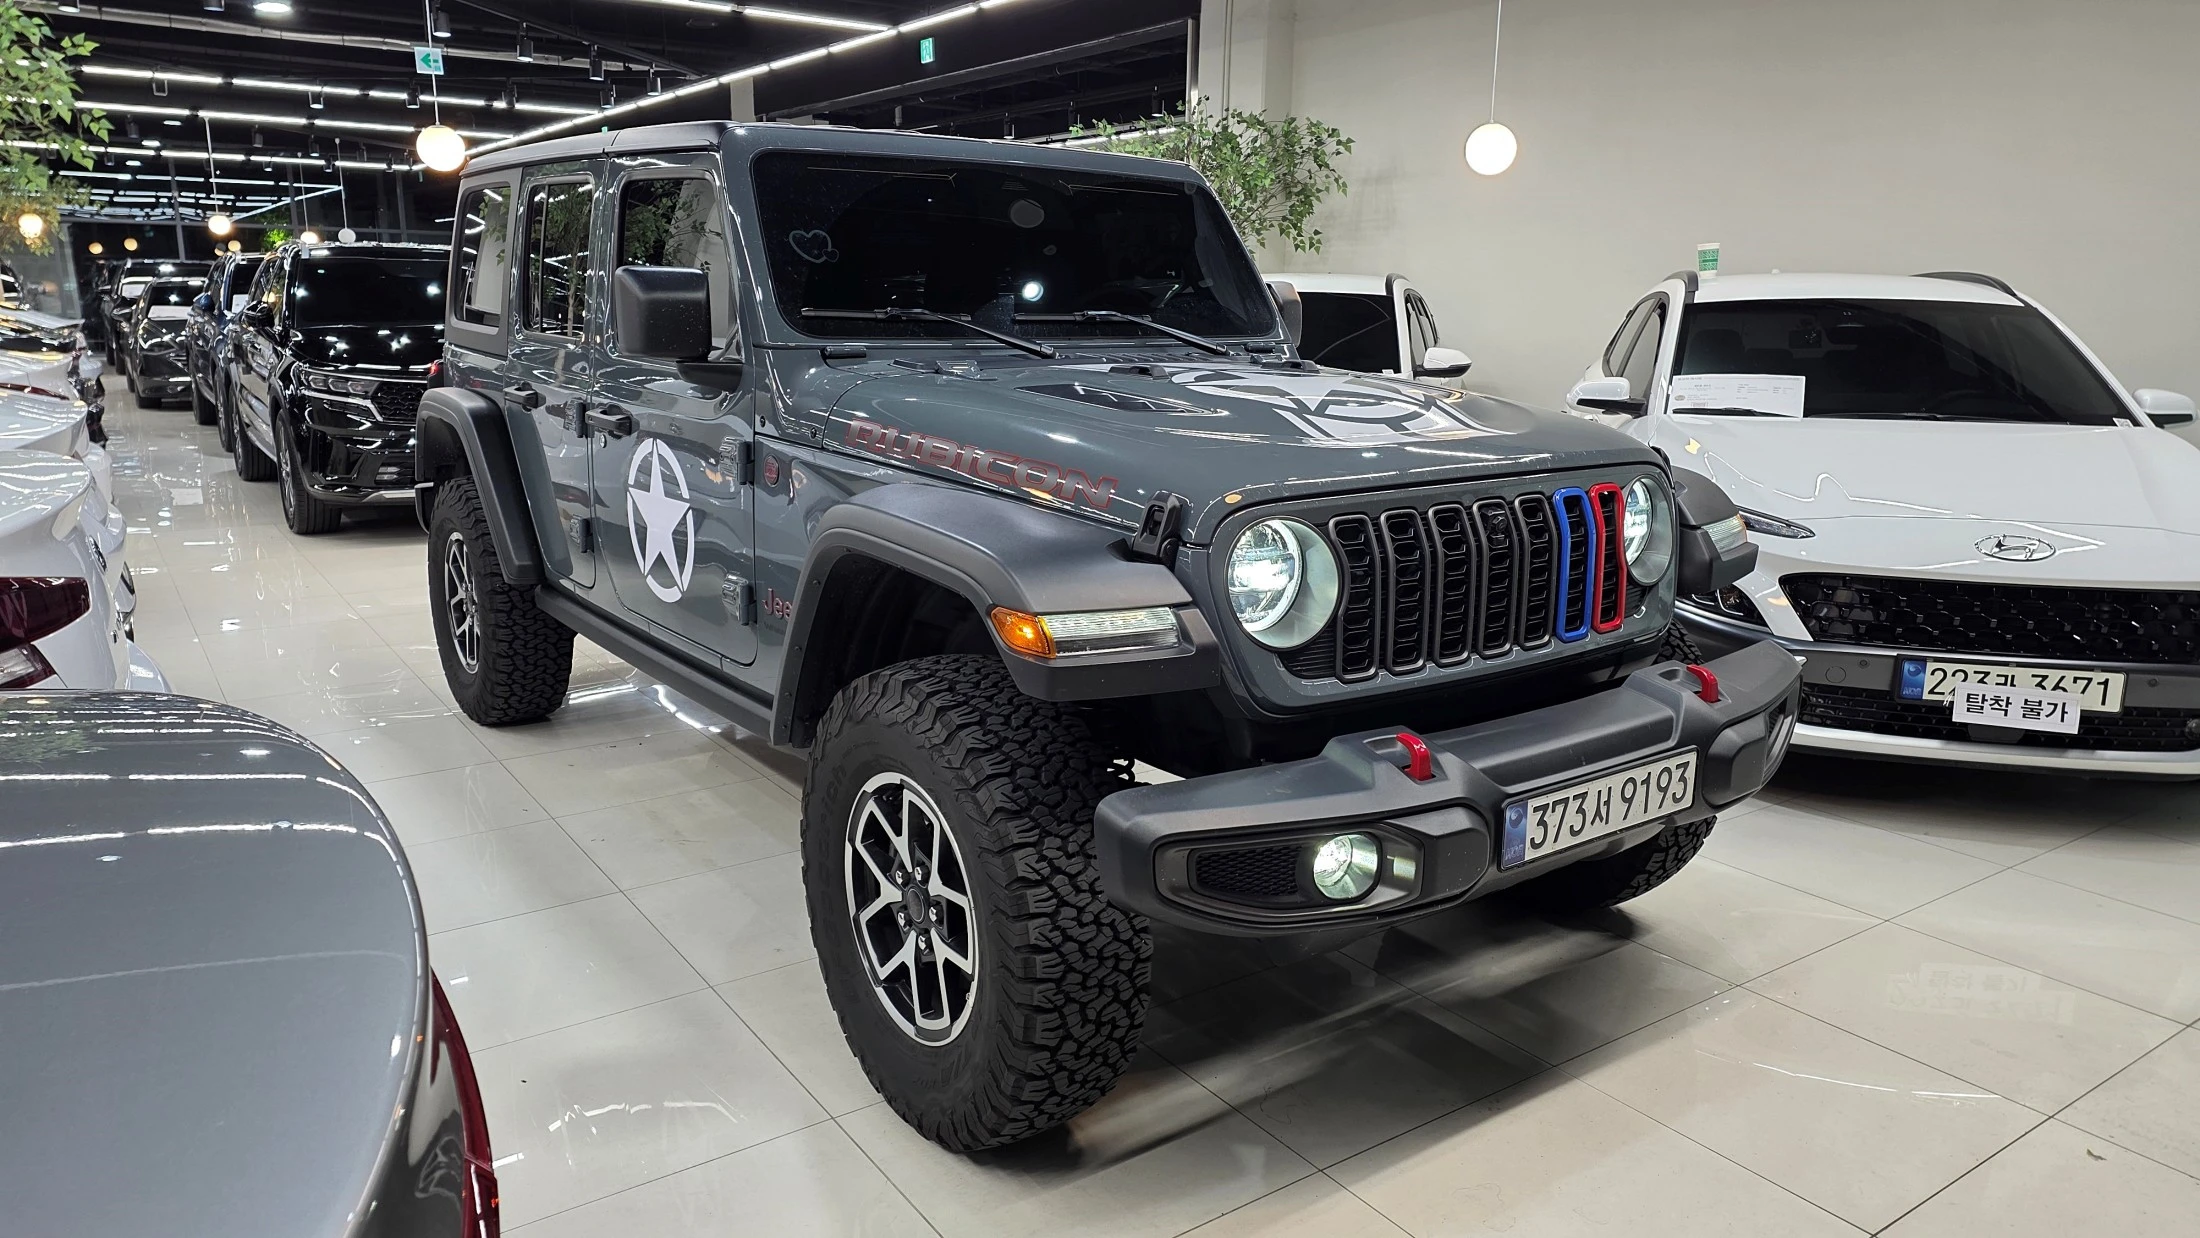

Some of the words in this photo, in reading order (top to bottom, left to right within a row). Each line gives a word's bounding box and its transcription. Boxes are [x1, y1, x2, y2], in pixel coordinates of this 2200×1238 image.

[846, 418, 1119, 509] RUBICON
[762, 587, 793, 622] Jee
[1965, 692, 2013, 717] 탈착
[2020, 698, 2069, 723] 불가
[1529, 785, 1613, 850] 373서
[1620, 760, 1690, 821] 9193
